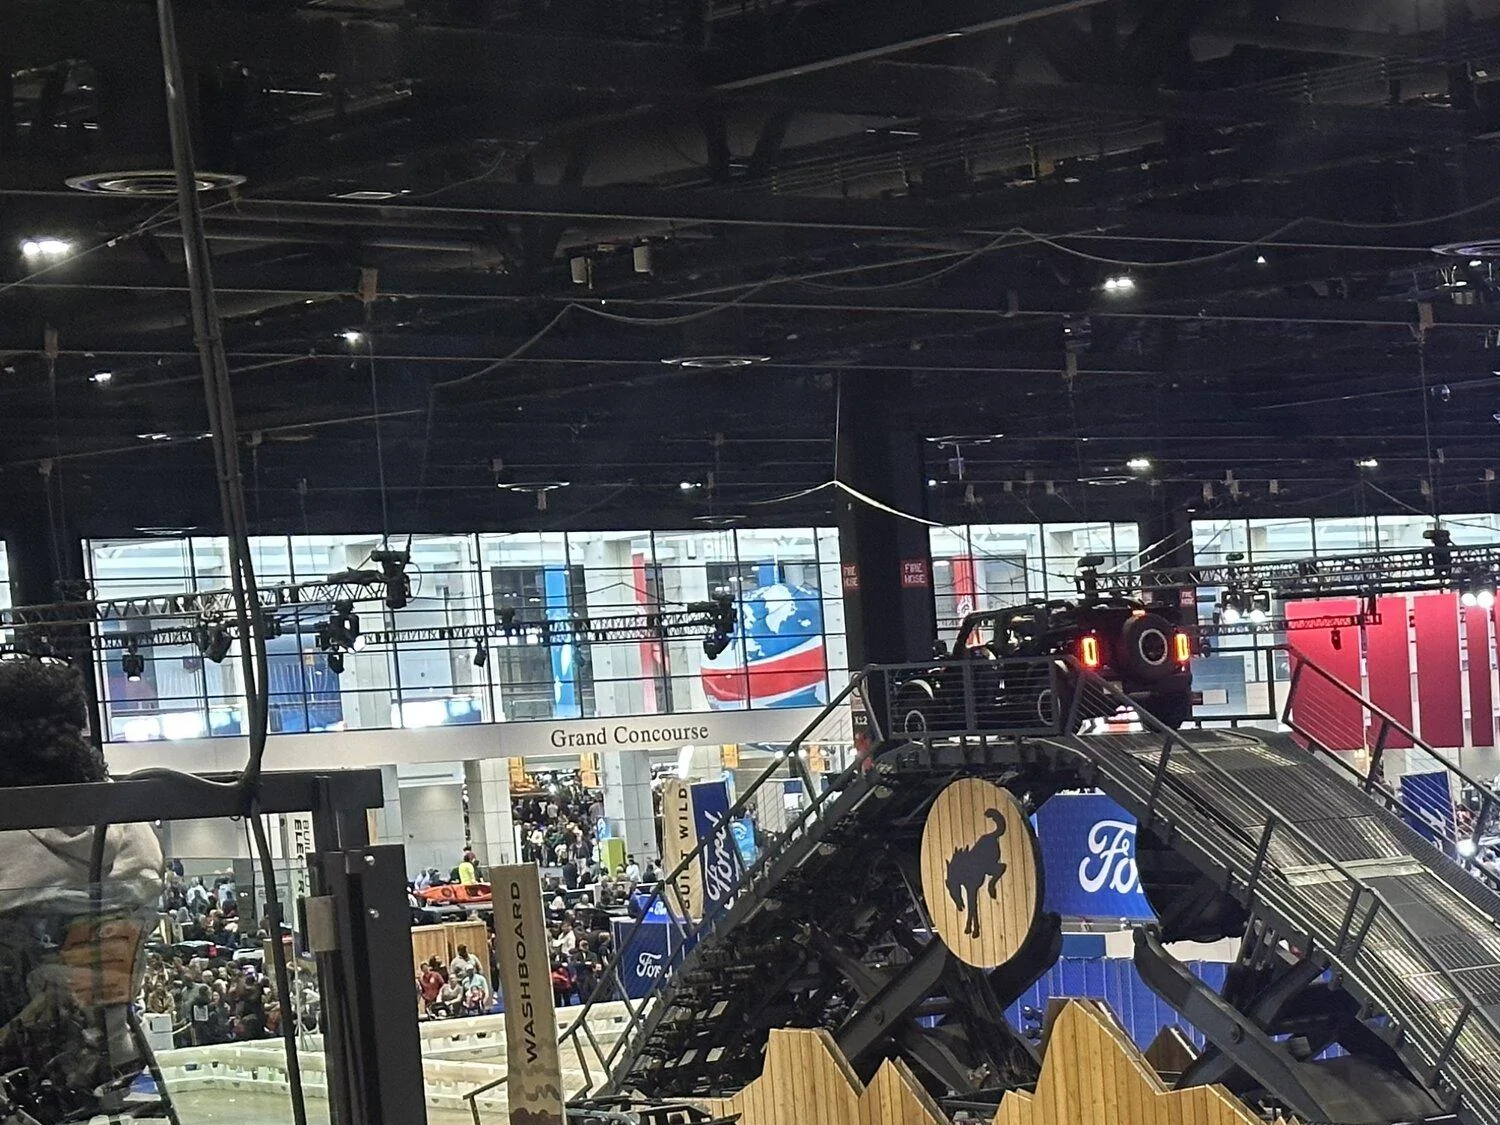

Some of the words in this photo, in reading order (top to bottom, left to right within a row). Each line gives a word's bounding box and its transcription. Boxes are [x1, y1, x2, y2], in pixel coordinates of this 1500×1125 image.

[904, 574, 925, 584] HOSE
[551, 727, 607, 747] Grand
[614, 726, 709, 744] Concourse
[678, 788, 689, 839] WILD
[1078, 820, 1144, 893] Fo
[510, 882, 538, 1063] WASHBOARD
